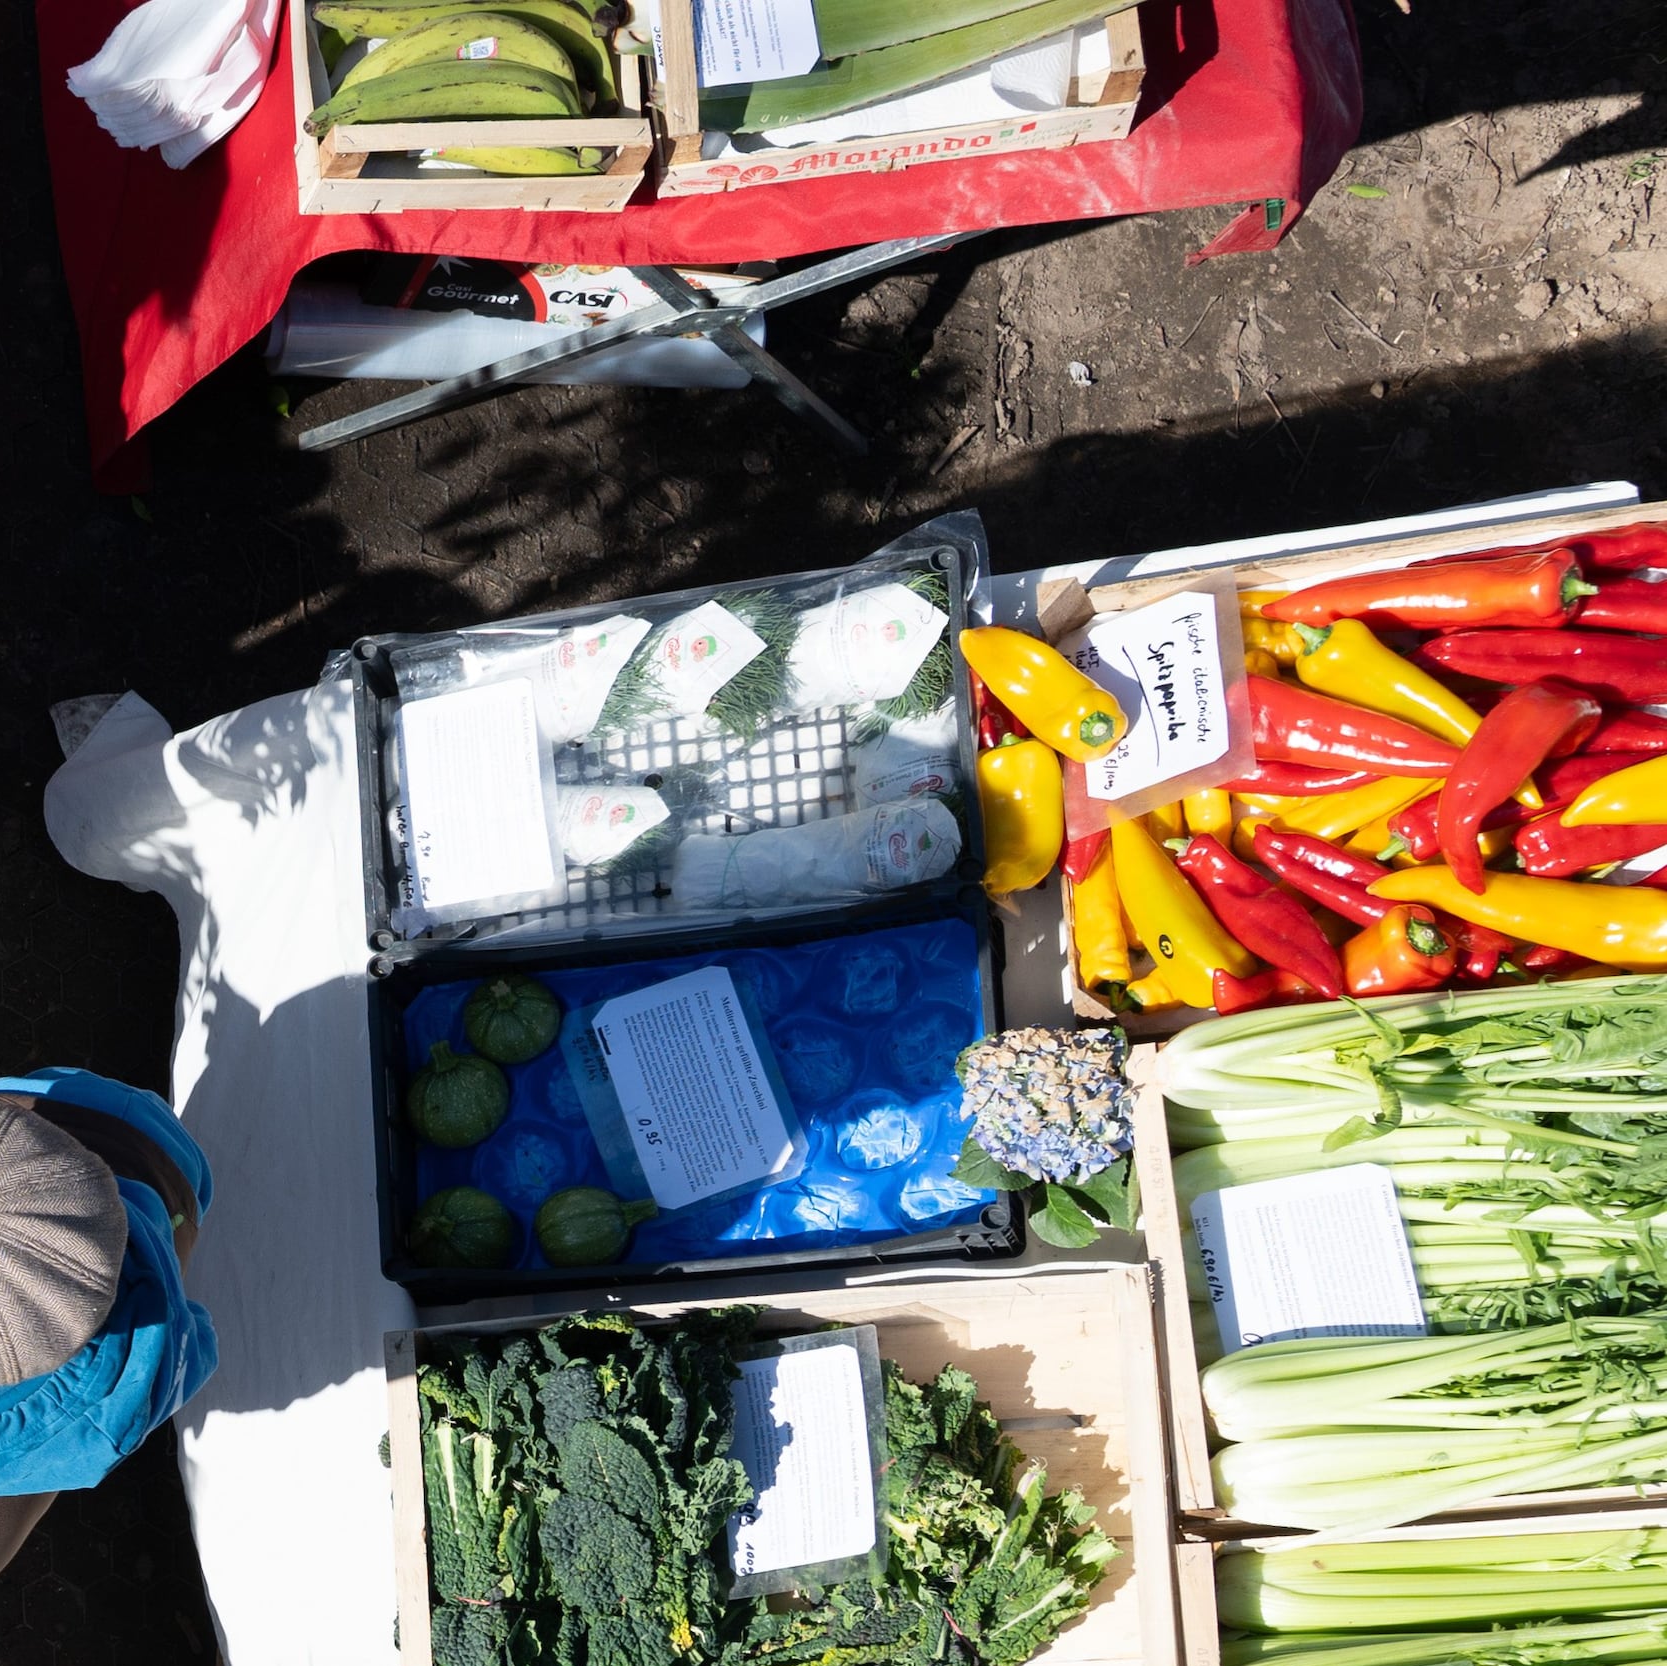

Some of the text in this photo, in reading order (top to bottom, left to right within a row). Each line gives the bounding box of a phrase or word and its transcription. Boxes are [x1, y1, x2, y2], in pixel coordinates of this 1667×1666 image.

[781, 134, 992, 175] Morando
[426, 285, 519, 305] Gourmet
[447, 283, 472, 292] Casi
[549, 291, 614, 308] CASI
[1170, 611, 1223, 744] frische italienische
[719, 996, 768, 1110] Mediterrane gefüllte Zucchini
[635, 1115, 662, 1149] 0,95
[1199, 1247, 1220, 1274] 6,90
